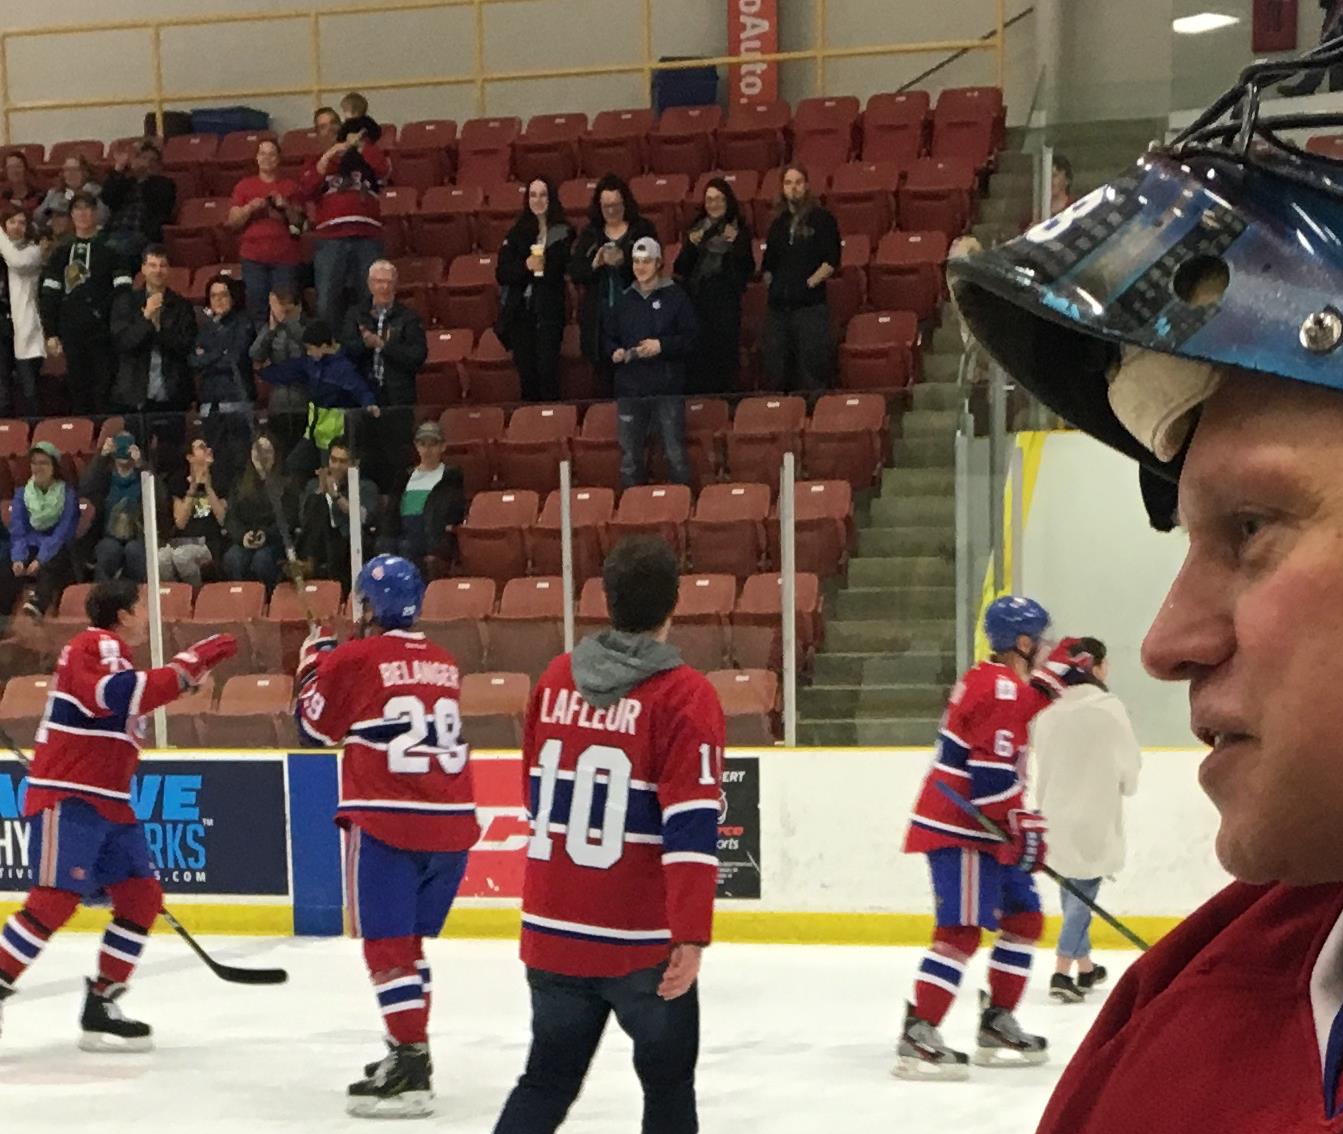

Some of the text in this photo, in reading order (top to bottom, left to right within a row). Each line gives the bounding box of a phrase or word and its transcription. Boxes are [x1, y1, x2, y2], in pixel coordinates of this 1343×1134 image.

[383, 695, 468, 774] 29
[540, 687, 642, 735] LAFLEUR
[699, 743, 722, 785] 1
[994, 729, 1015, 757] 6
[528, 738, 632, 869] 10
